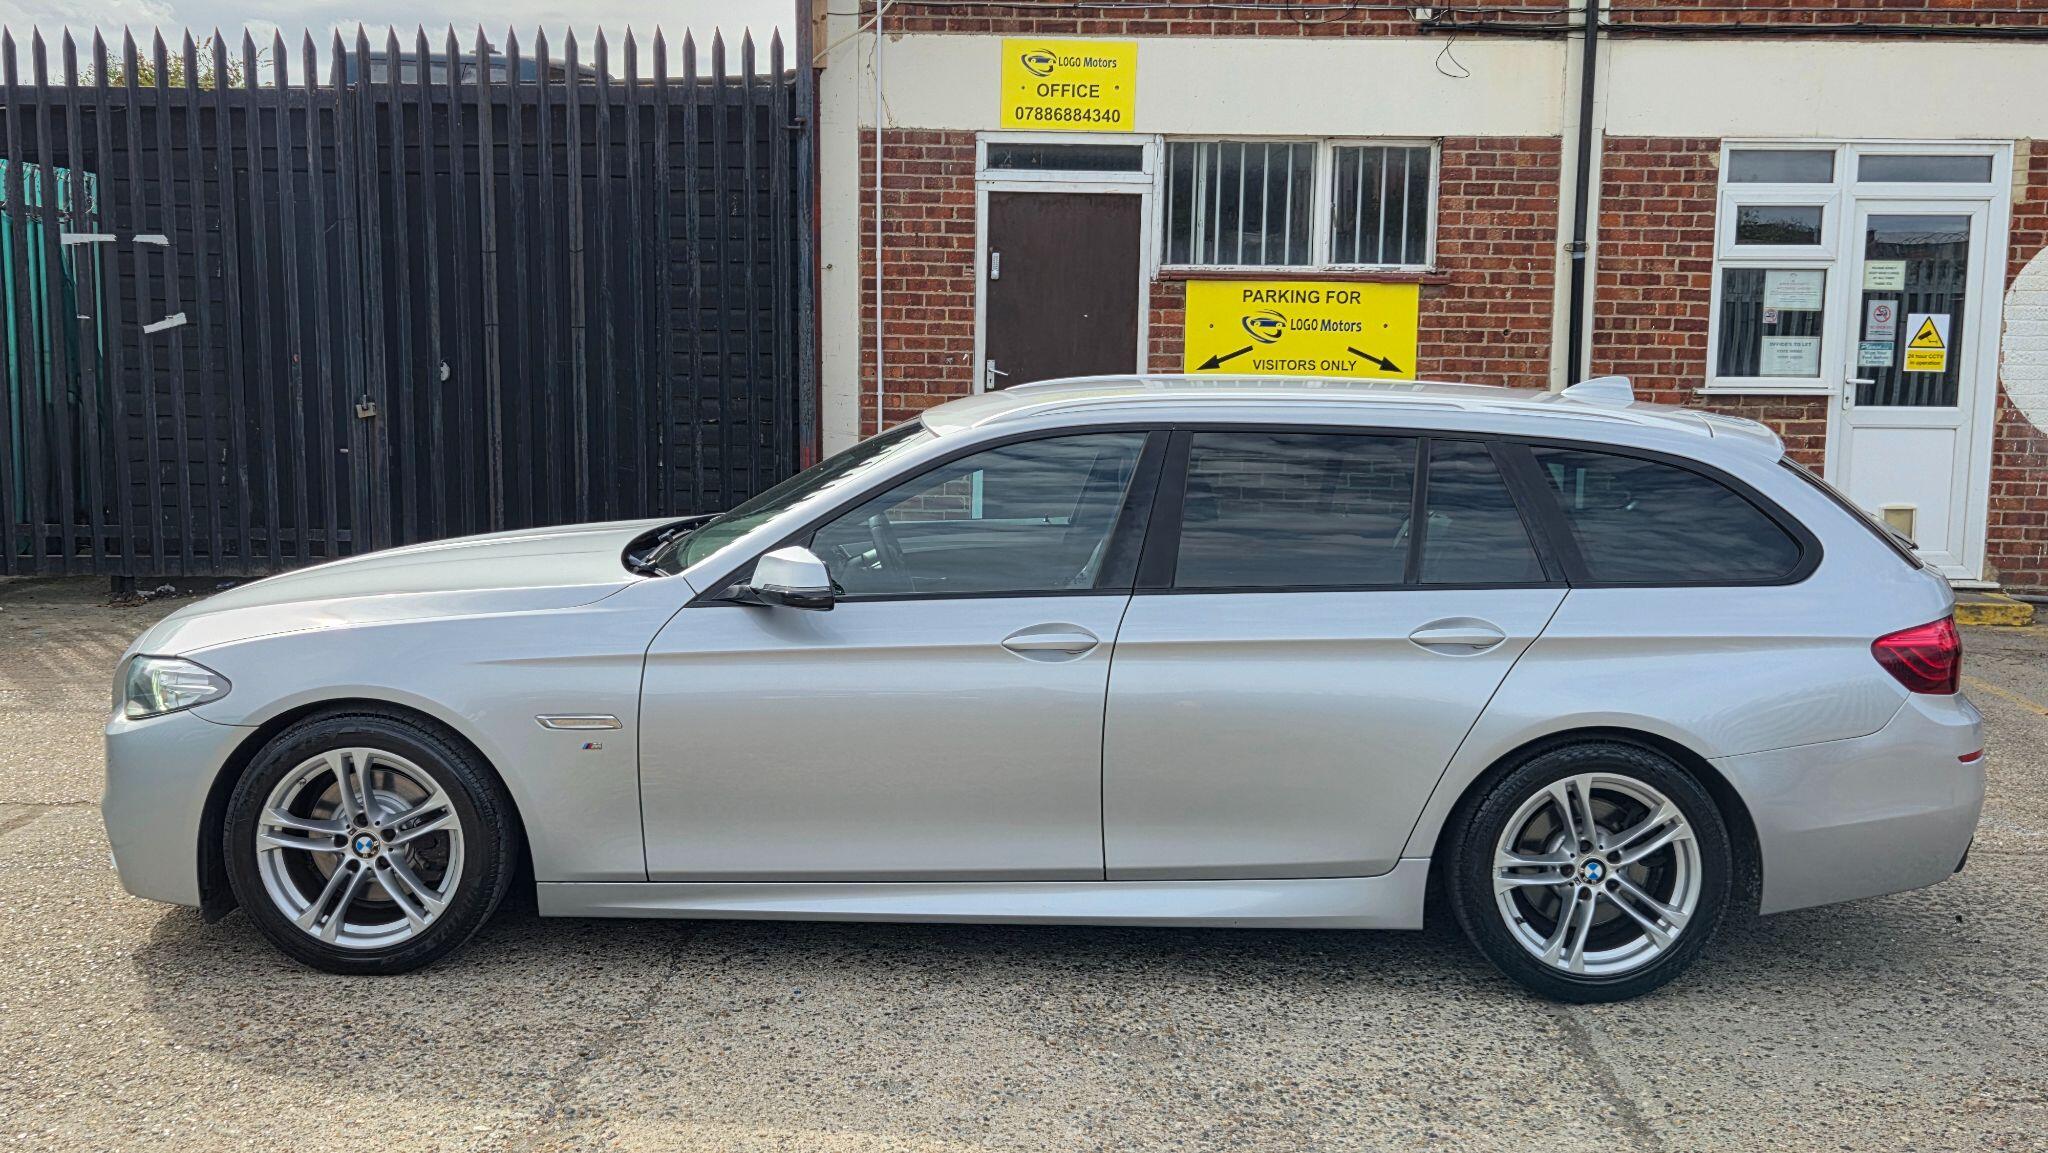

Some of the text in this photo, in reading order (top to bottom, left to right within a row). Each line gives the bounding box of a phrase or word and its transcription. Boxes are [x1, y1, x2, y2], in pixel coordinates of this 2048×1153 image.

[1058, 56, 1117, 68] LOGO Motors
[1036, 83, 1100, 98] OFFICE
[1015, 106, 1121, 123] 07886884340
[1242, 289, 1361, 304] PARKING FOR
[1290, 318, 1362, 332] LOGO Motors
[1253, 359, 1357, 371] VISITORS ONLY
